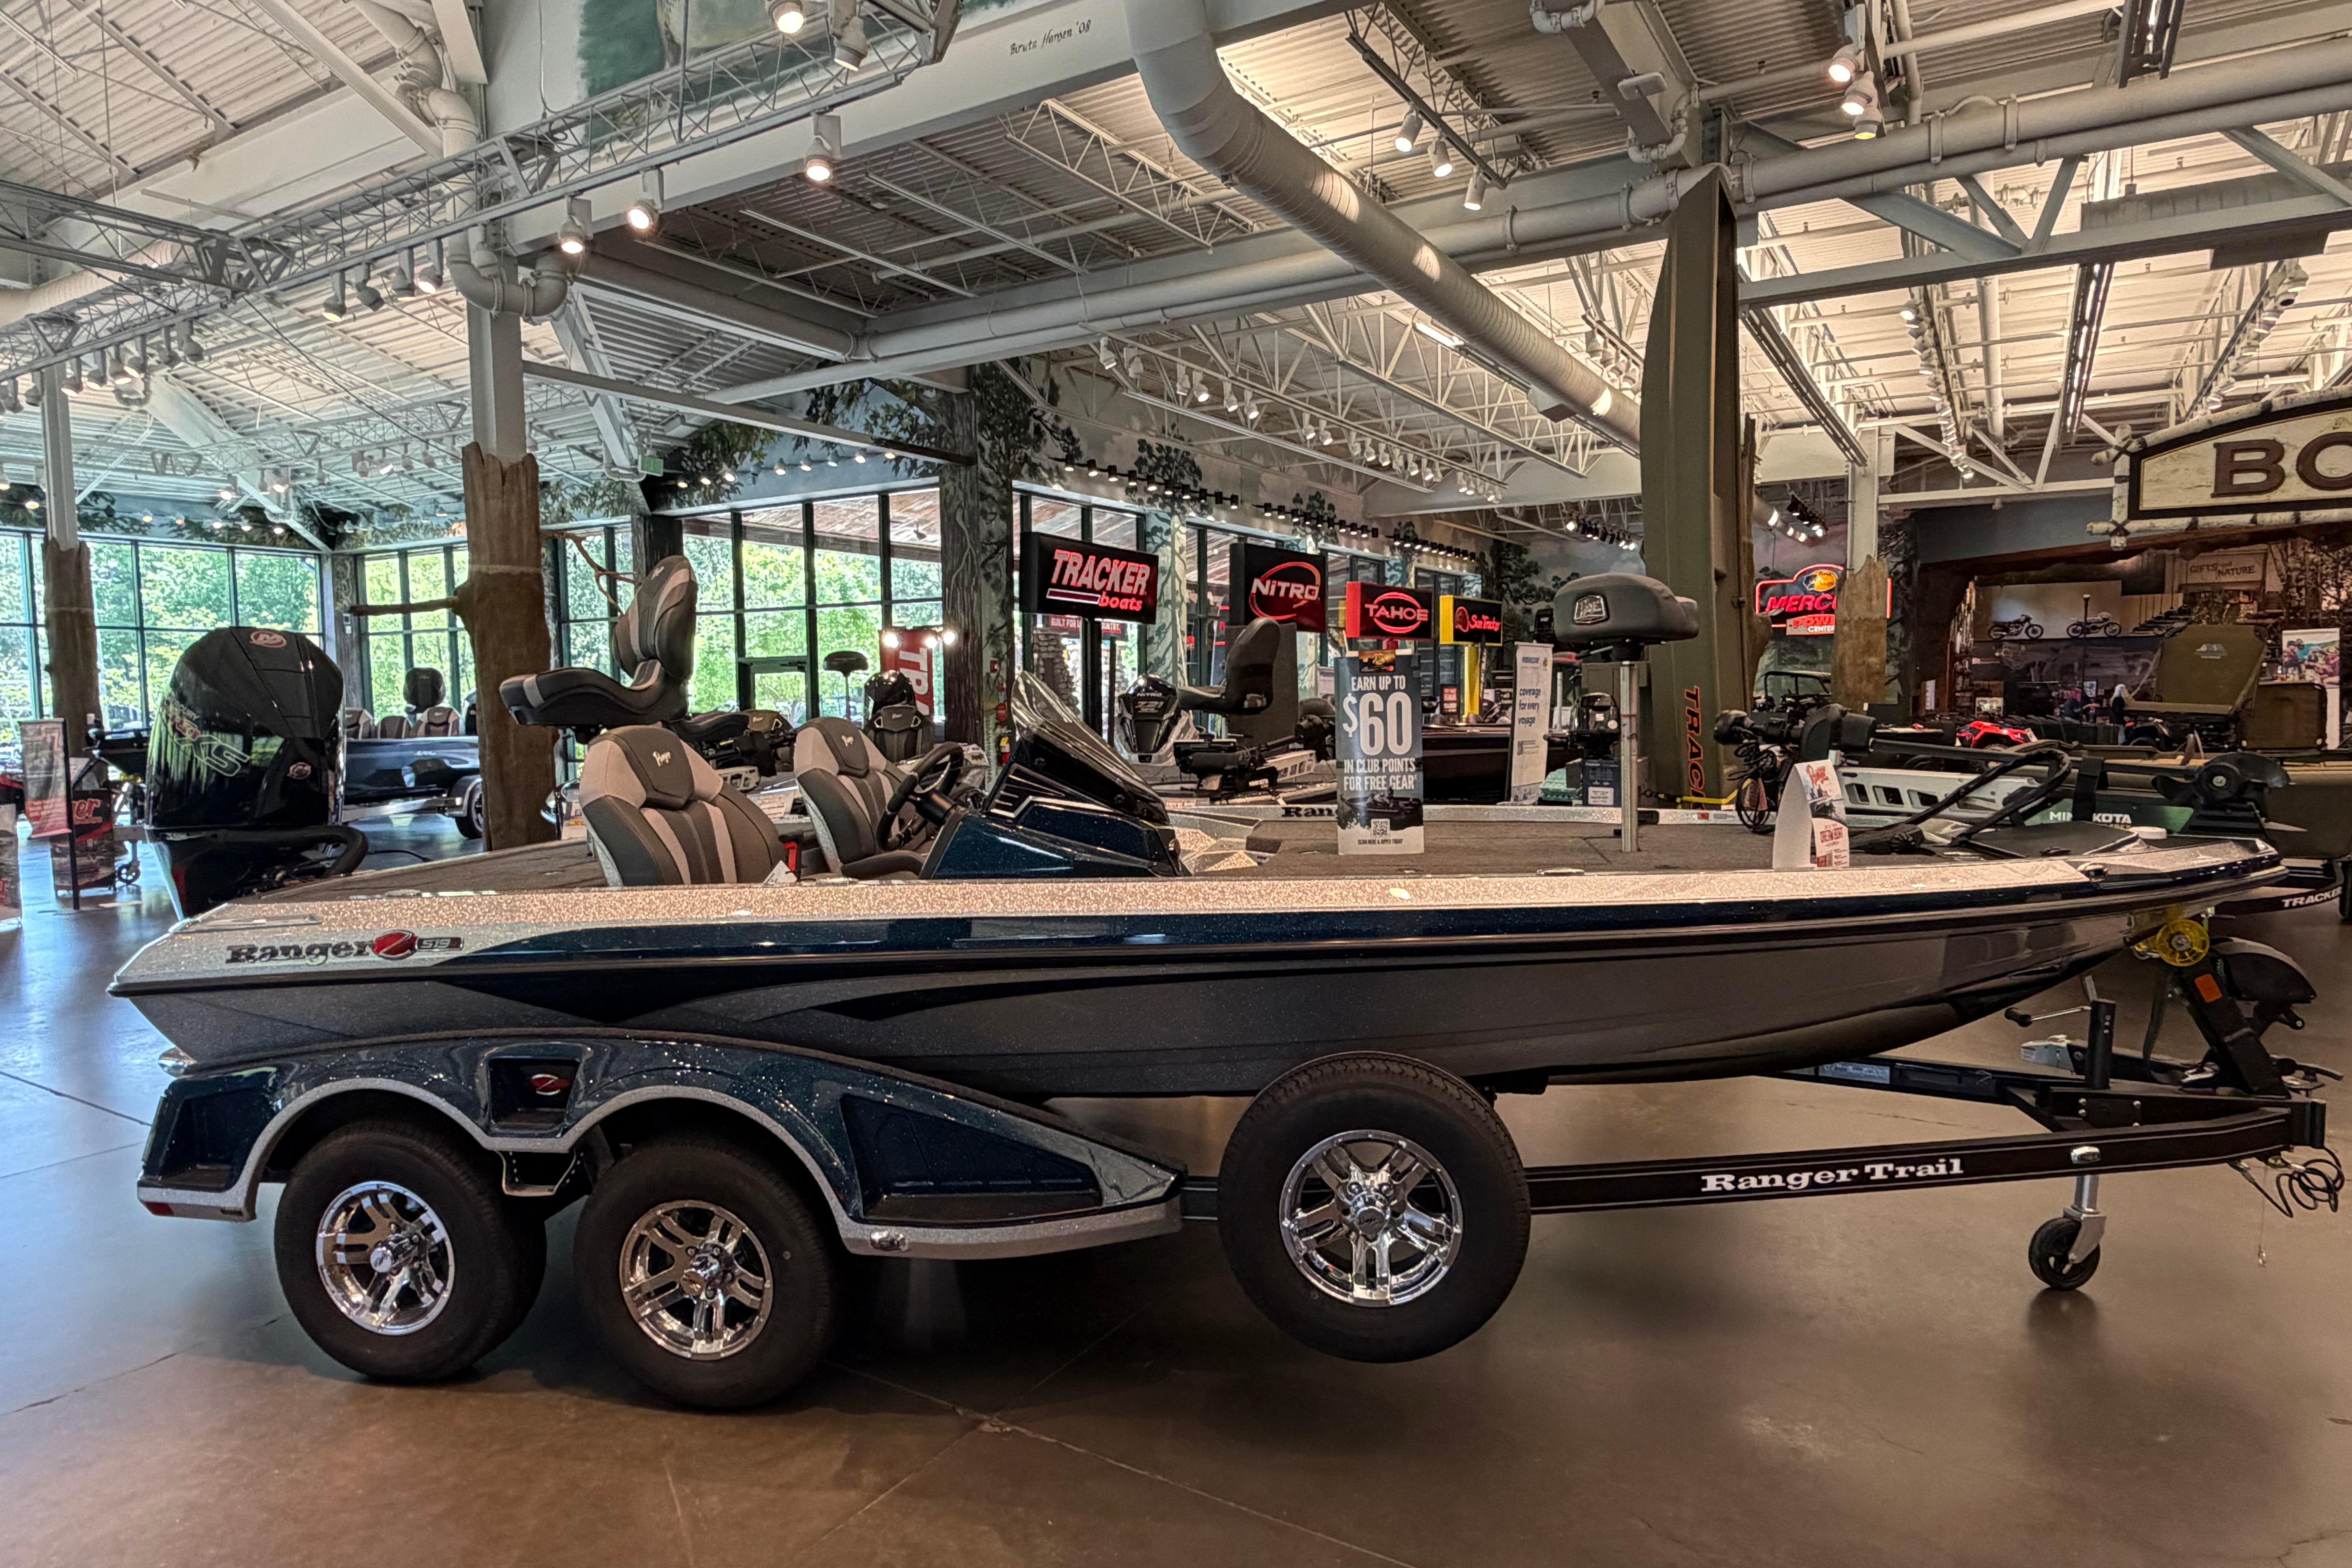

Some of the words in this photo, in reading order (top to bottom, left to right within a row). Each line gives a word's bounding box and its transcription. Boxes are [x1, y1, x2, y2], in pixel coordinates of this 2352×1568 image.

[1051, 549, 1150, 595] TRACKER
[2218, 565, 2256, 576] NATURE
[1098, 591, 1143, 611] boats
[1765, 594, 1837, 612] MERC
[1365, 604, 1429, 621] TAHOE
[1351, 676, 1377, 691] EARN
[1379, 675, 1392, 690] UP
[1393, 675, 1406, 690] TO
[1519, 688, 1542, 698] coverage
[1342, 692, 1412, 756] $60
[1344, 759, 1354, 773] IN
[1356, 758, 1380, 773] CLUB
[1382, 758, 1416, 772] POINTS
[1344, 775, 1362, 791] FOR
[1364, 775, 1387, 791] FREE
[1281, 806, 1338, 819] Ran
[2092, 813, 2132, 824] KOTA
[226, 941, 374, 965] Ranger
[1701, 1169, 1858, 1192] Ranger
[1864, 1158, 1964, 1180] Trail
